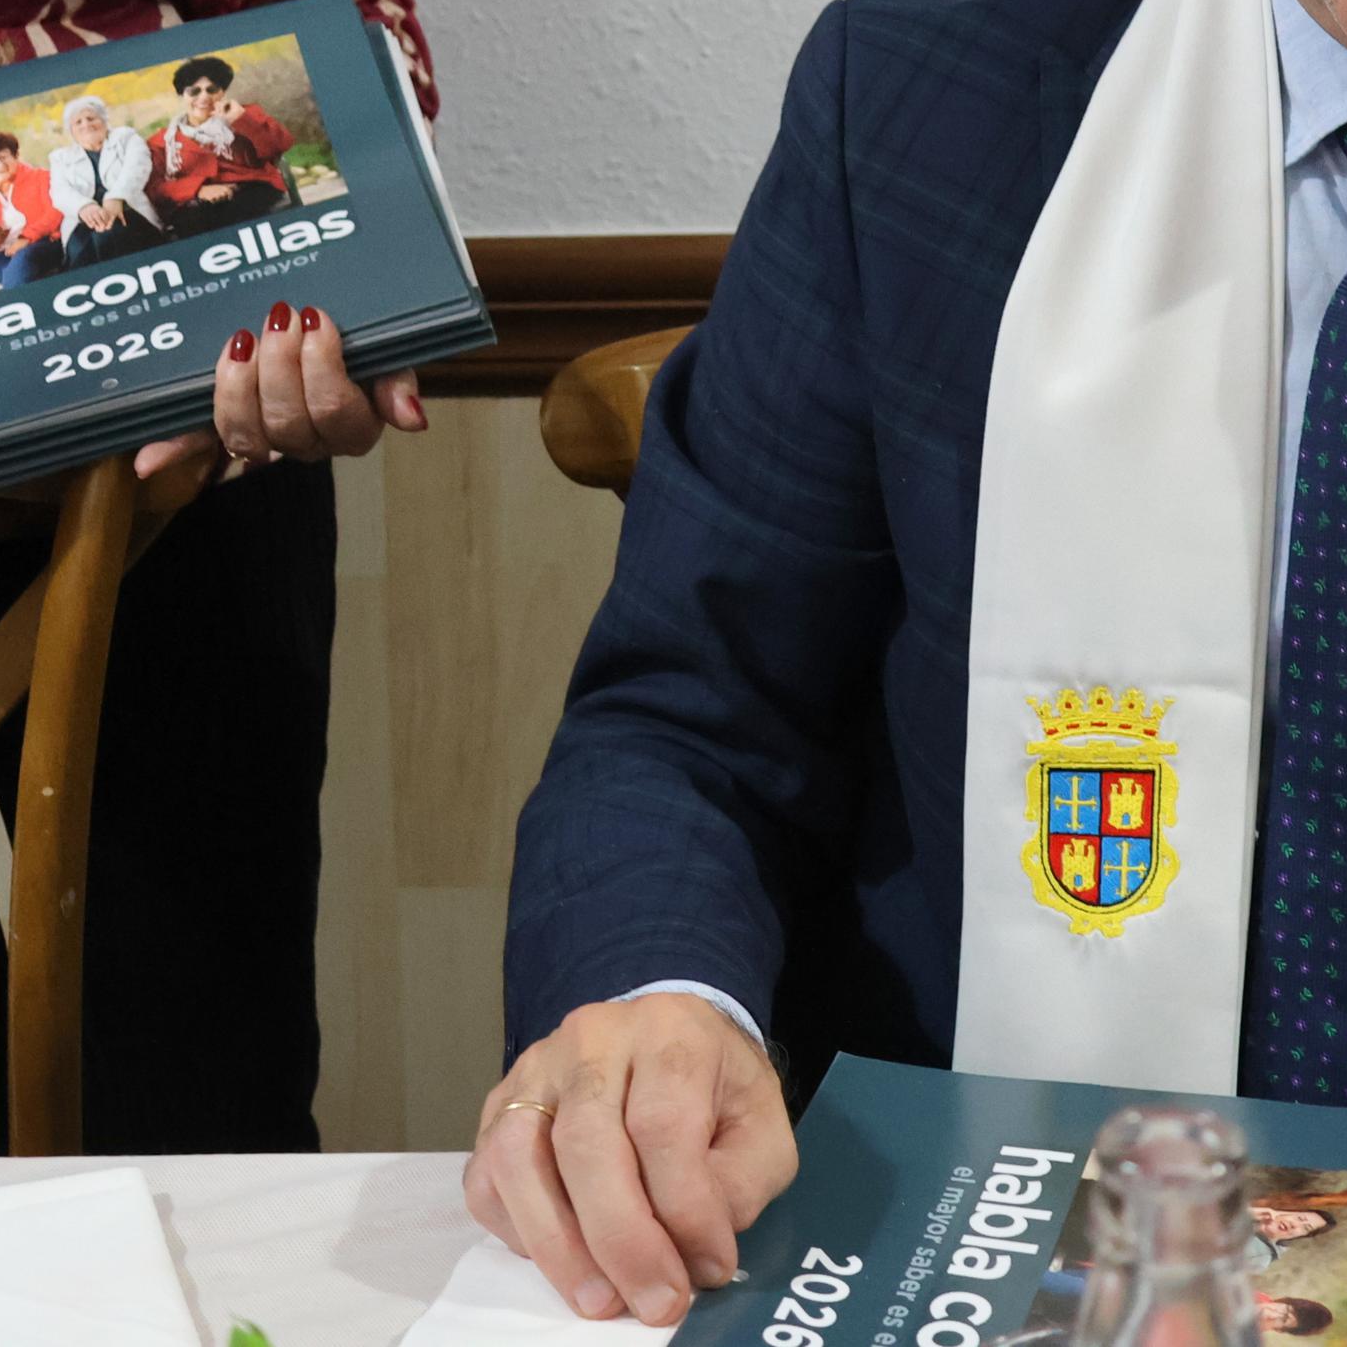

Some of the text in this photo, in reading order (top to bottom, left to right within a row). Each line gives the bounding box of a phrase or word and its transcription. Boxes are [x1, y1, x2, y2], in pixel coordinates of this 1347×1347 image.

[52, 259, 184, 317] con
[199, 209, 356, 274] ellas
[10, 319, 82, 351] saber
[90, 309, 120, 327] es
[127, 298, 151, 317] el
[158, 276, 231, 308] saber
[238, 250, 320, 284] mayor
[42, 322, 184, 383] 2026
[950, 1165, 976, 1184] el
[923, 1185, 965, 1245] mayor
[895, 1246, 937, 1302] saber
[915, 1145, 1076, 1347] habla co
[762, 1246, 864, 1347] 2026
[882, 1305, 909, 1328] es
